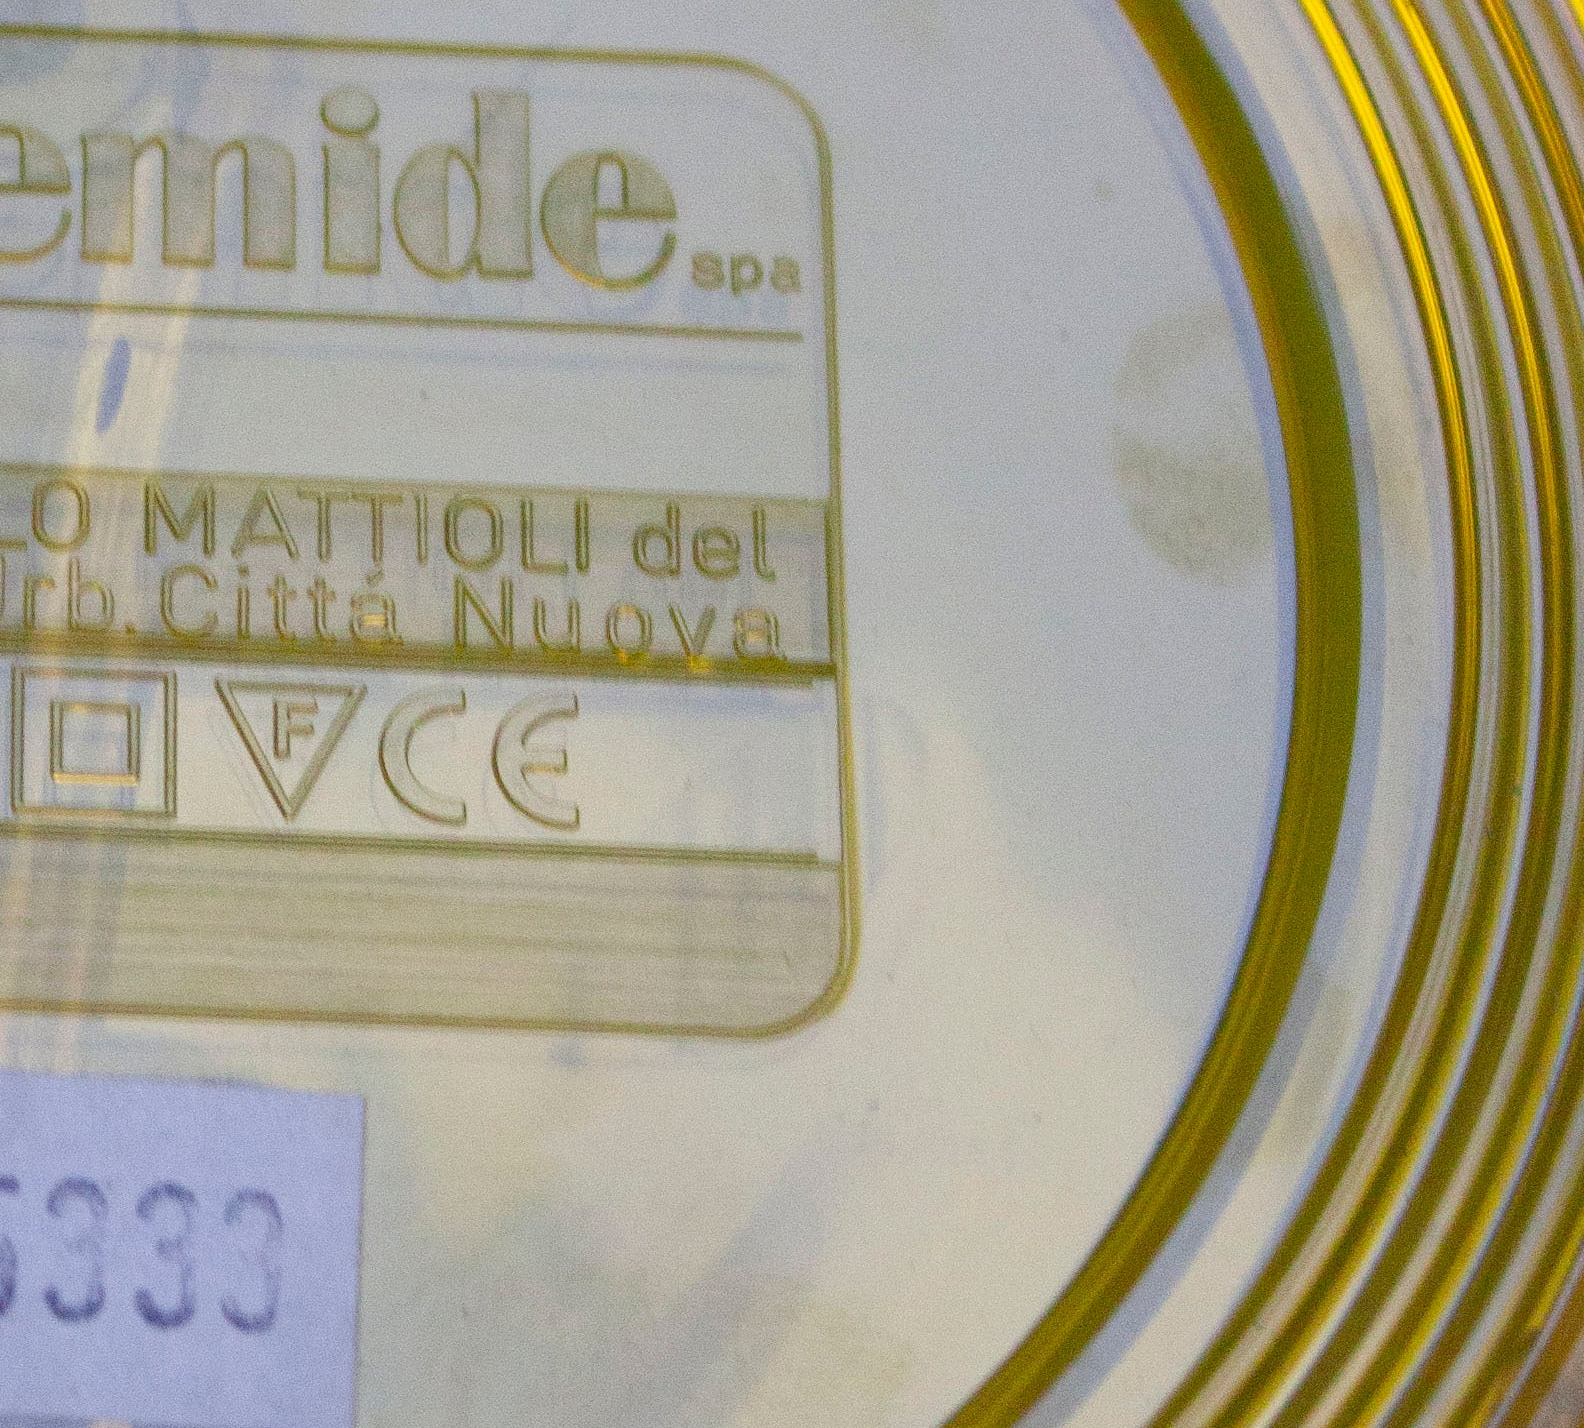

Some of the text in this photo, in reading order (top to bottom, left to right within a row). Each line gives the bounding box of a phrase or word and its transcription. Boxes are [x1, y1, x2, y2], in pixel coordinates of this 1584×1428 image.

[691, 248, 803, 297] spa
[144, 479, 591, 574] MATTIOLI
[632, 501, 778, 583] del
[454, 575, 788, 662] Nuova
